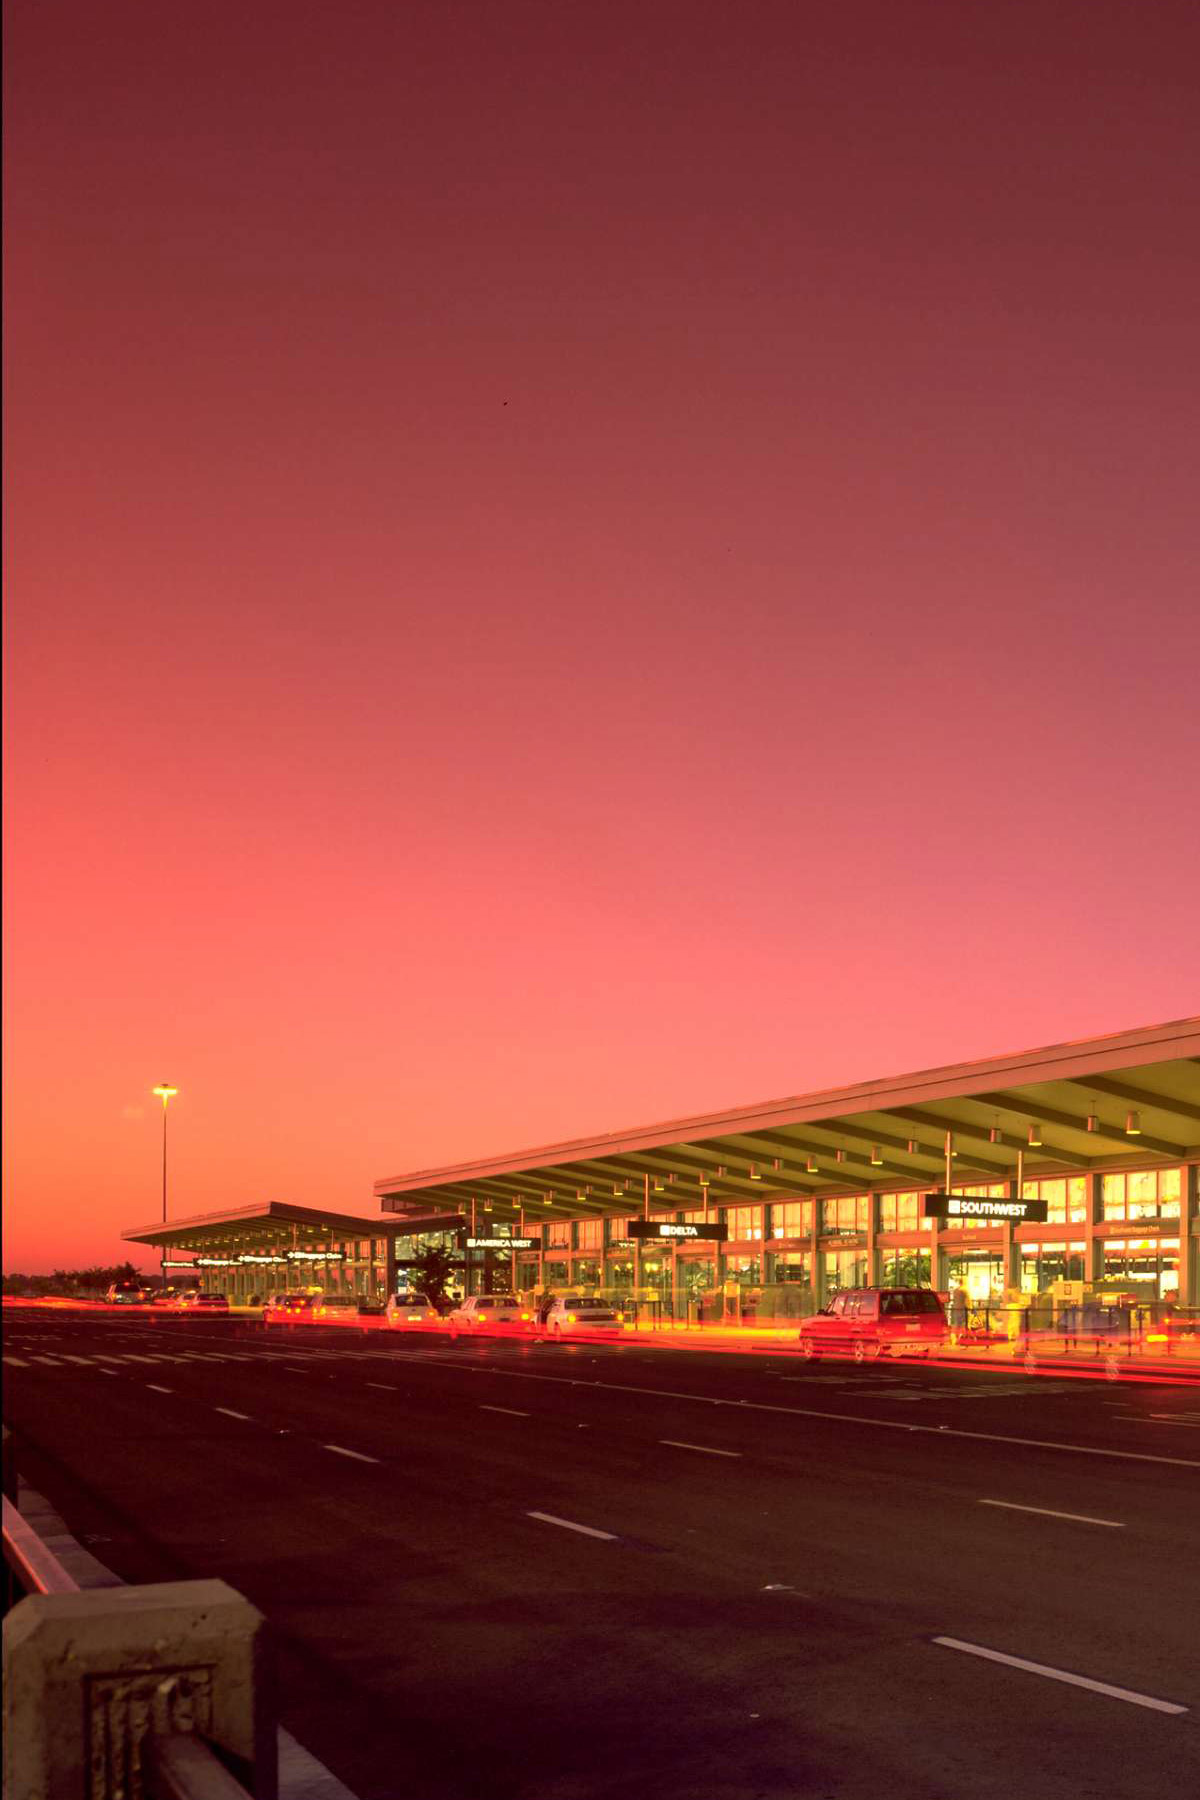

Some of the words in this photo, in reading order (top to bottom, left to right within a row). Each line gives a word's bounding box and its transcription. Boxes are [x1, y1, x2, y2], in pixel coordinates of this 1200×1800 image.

[961, 1201, 1027, 1216] SOUTHWEST
[670, 1226, 698, 1236] DELTA
[476, 1239, 511, 1247] AMERICA
[511, 1239, 532, 1248] WEST
